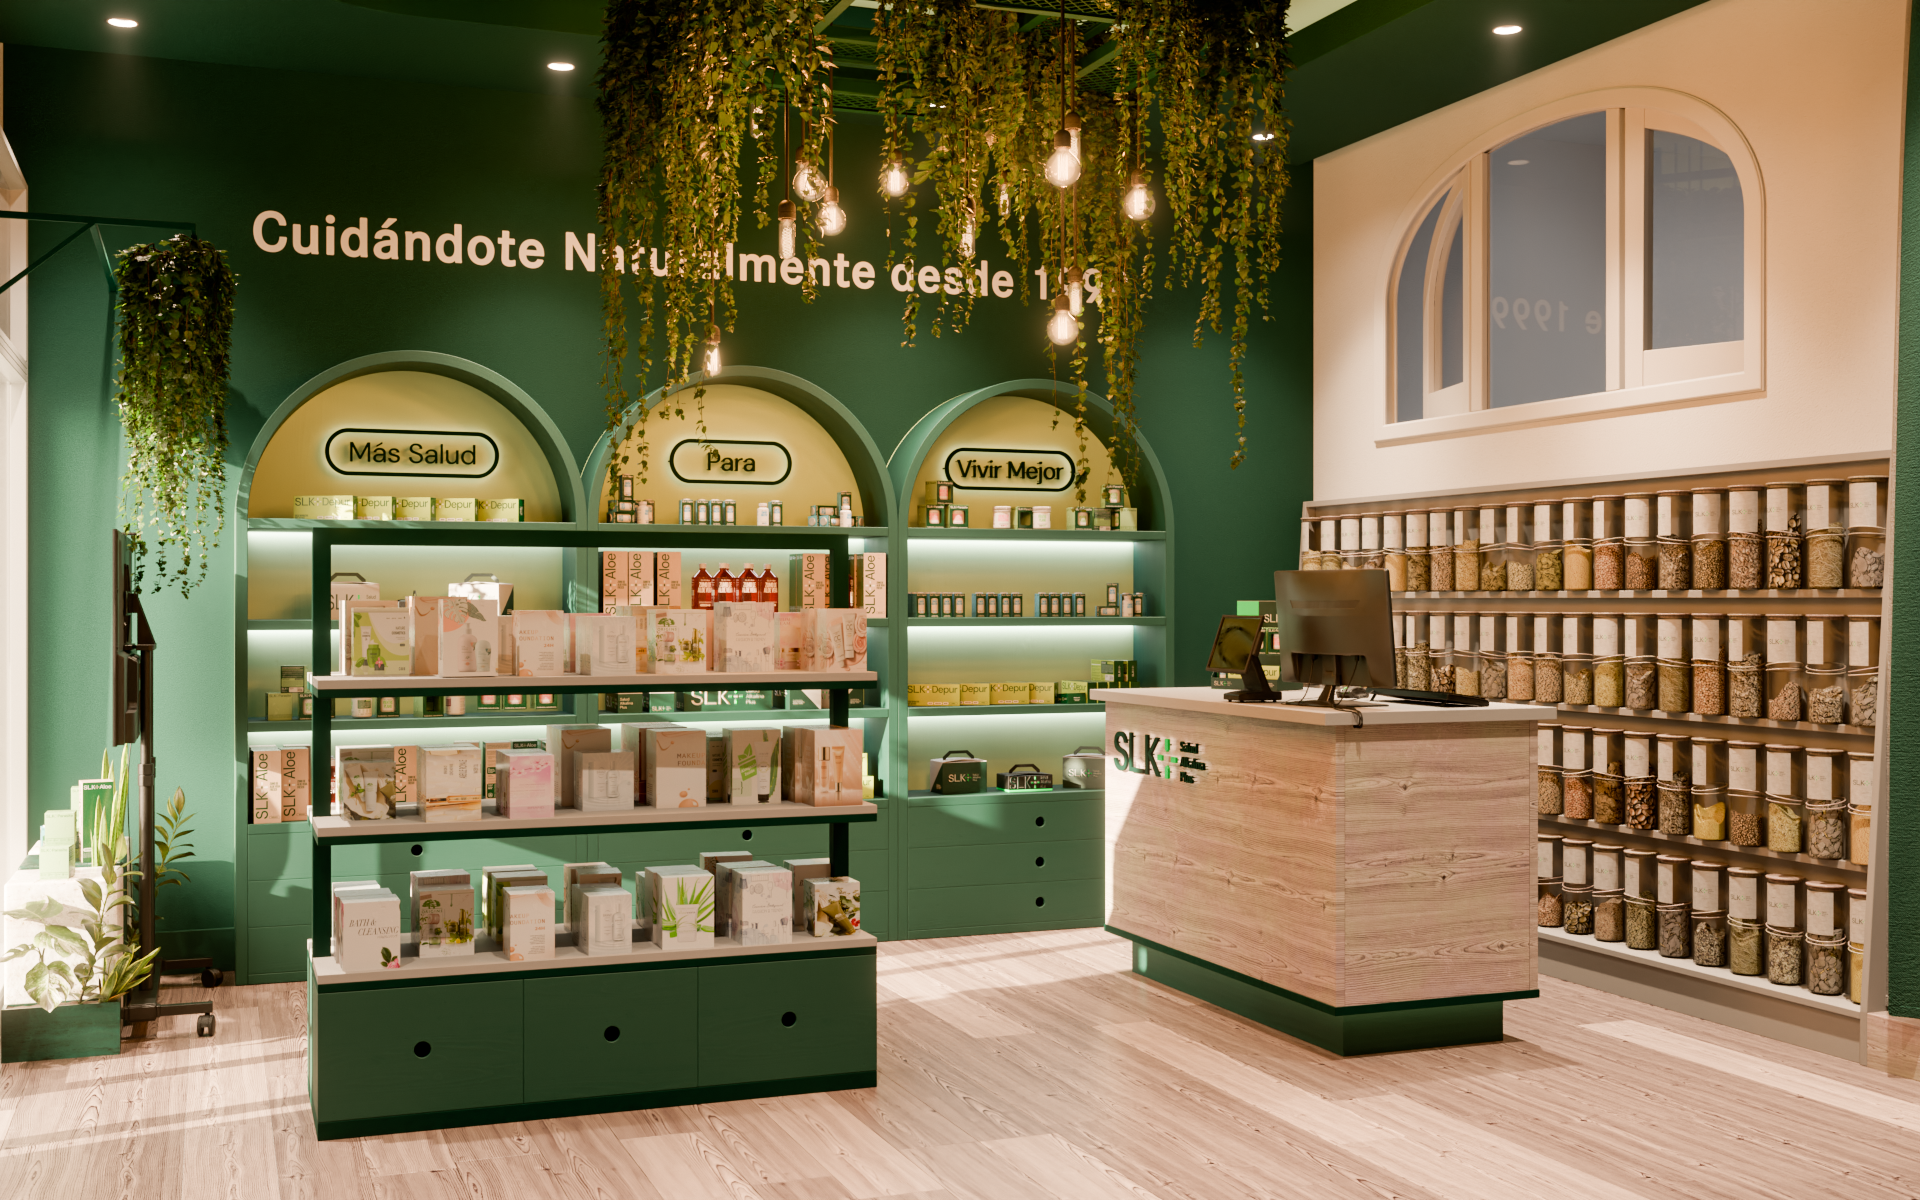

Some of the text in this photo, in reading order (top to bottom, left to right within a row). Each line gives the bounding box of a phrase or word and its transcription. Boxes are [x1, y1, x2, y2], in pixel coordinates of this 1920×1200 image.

[252, 209, 545, 269] Cuidándote
[890, 258, 1014, 299] desde
[349, 442, 477, 466] Más Salud
[706, 451, 756, 473] Para
[956, 459, 1064, 485] Vivir Mejor
[295, 497, 350, 508] SLK Depur
[361, 498, 389, 509] Depur
[401, 499, 428, 510] Depur
[444, 500, 472, 511] Depur
[491, 500, 517, 512] Depur
[605, 553, 616, 579] Aloe
[804, 555, 815, 580] Aloe
[865, 555, 875, 580] Aloe
[630, 553, 641, 606] LK Aloe
[659, 553, 670, 606] LK Aloe
[907, 685, 958, 695] SLK Depur
[961, 684, 988, 695] Depur
[1002, 683, 1028, 694] Depur
[1028, 683, 1052, 693] Depur
[690, 690, 731, 706] SLK
[1113, 731, 1161, 777] SLK
[395, 748, 407, 803] LK Aloe
[948, 773, 966, 783] SLK
[1068, 768, 1086, 778] SLK
[255, 753, 268, 820] SLK Aloe
[283, 751, 296, 817] SLK Aloe
[1008, 775, 1030, 790] SLK
[349, 918, 370, 928] BATH
[509, 918, 546, 926] OUNDATION
[357, 926, 400, 936] CLEANSING
